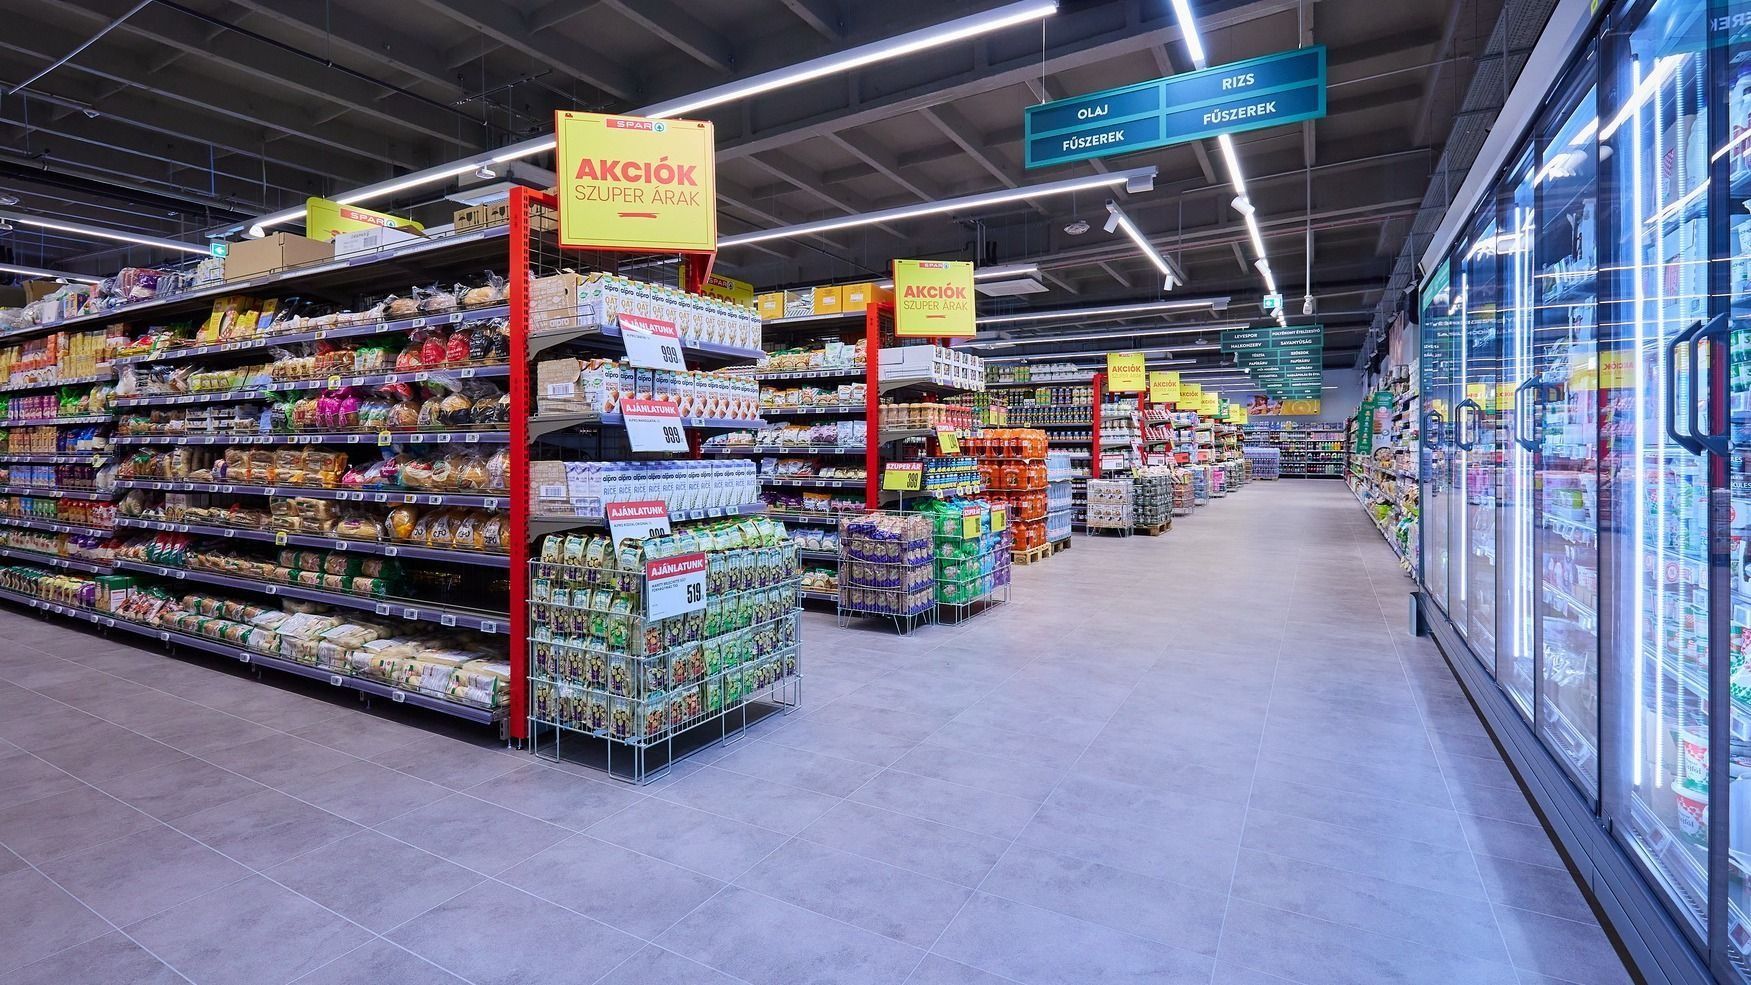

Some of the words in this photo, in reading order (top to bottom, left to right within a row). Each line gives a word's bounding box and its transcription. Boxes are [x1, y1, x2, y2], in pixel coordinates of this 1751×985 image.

[1222, 73, 1255, 90] RIZS
[1077, 104, 1109, 119] OLAJ
[1203, 101, 1277, 125] FŰSZEREK
[616, 120, 652, 130] SPAR
[1063, 130, 1125, 151] FŰSZEREK
[575, 156, 698, 186] AKCIÓK
[575, 184, 644, 204] SZUPER
[651, 186, 700, 207] ÁRAK
[350, 211, 384, 227] SPAR
[708, 277, 727, 288] SPAR
[604, 284, 619, 292] alpro
[620, 287, 634, 296] alpro
[903, 282, 967, 299] AKCIÓK
[636, 290, 650, 299] alpro
[651, 294, 664, 302] alpro
[903, 300, 940, 311] SZUPER
[942, 299, 968, 311] ÁRAK
[661, 345, 679, 363] 999
[1112, 363, 1141, 374] AKCIÓK
[604, 371, 619, 379] alpro
[620, 372, 634, 380] alpro
[637, 375, 652, 383] alpro
[655, 377, 669, 385] alpro
[1153, 380, 1177, 388] AKCIÓK
[626, 402, 677, 414] AJÁNLATUNK
[663, 426, 681, 444] 999
[602, 475, 617, 483] alpro
[618, 473, 632, 482] alpro
[633, 473, 647, 482] alpro
[648, 473, 661, 481] alpro
[662, 472, 674, 480] alpro
[675, 471, 687, 480] alpro
[603, 487, 617, 495] RICE
[619, 486, 631, 494] RICE
[611, 506, 664, 517] AJÁNLATUNK
[651, 559, 704, 577] AJÁNLATUNK
[687, 582, 702, 604] 519
